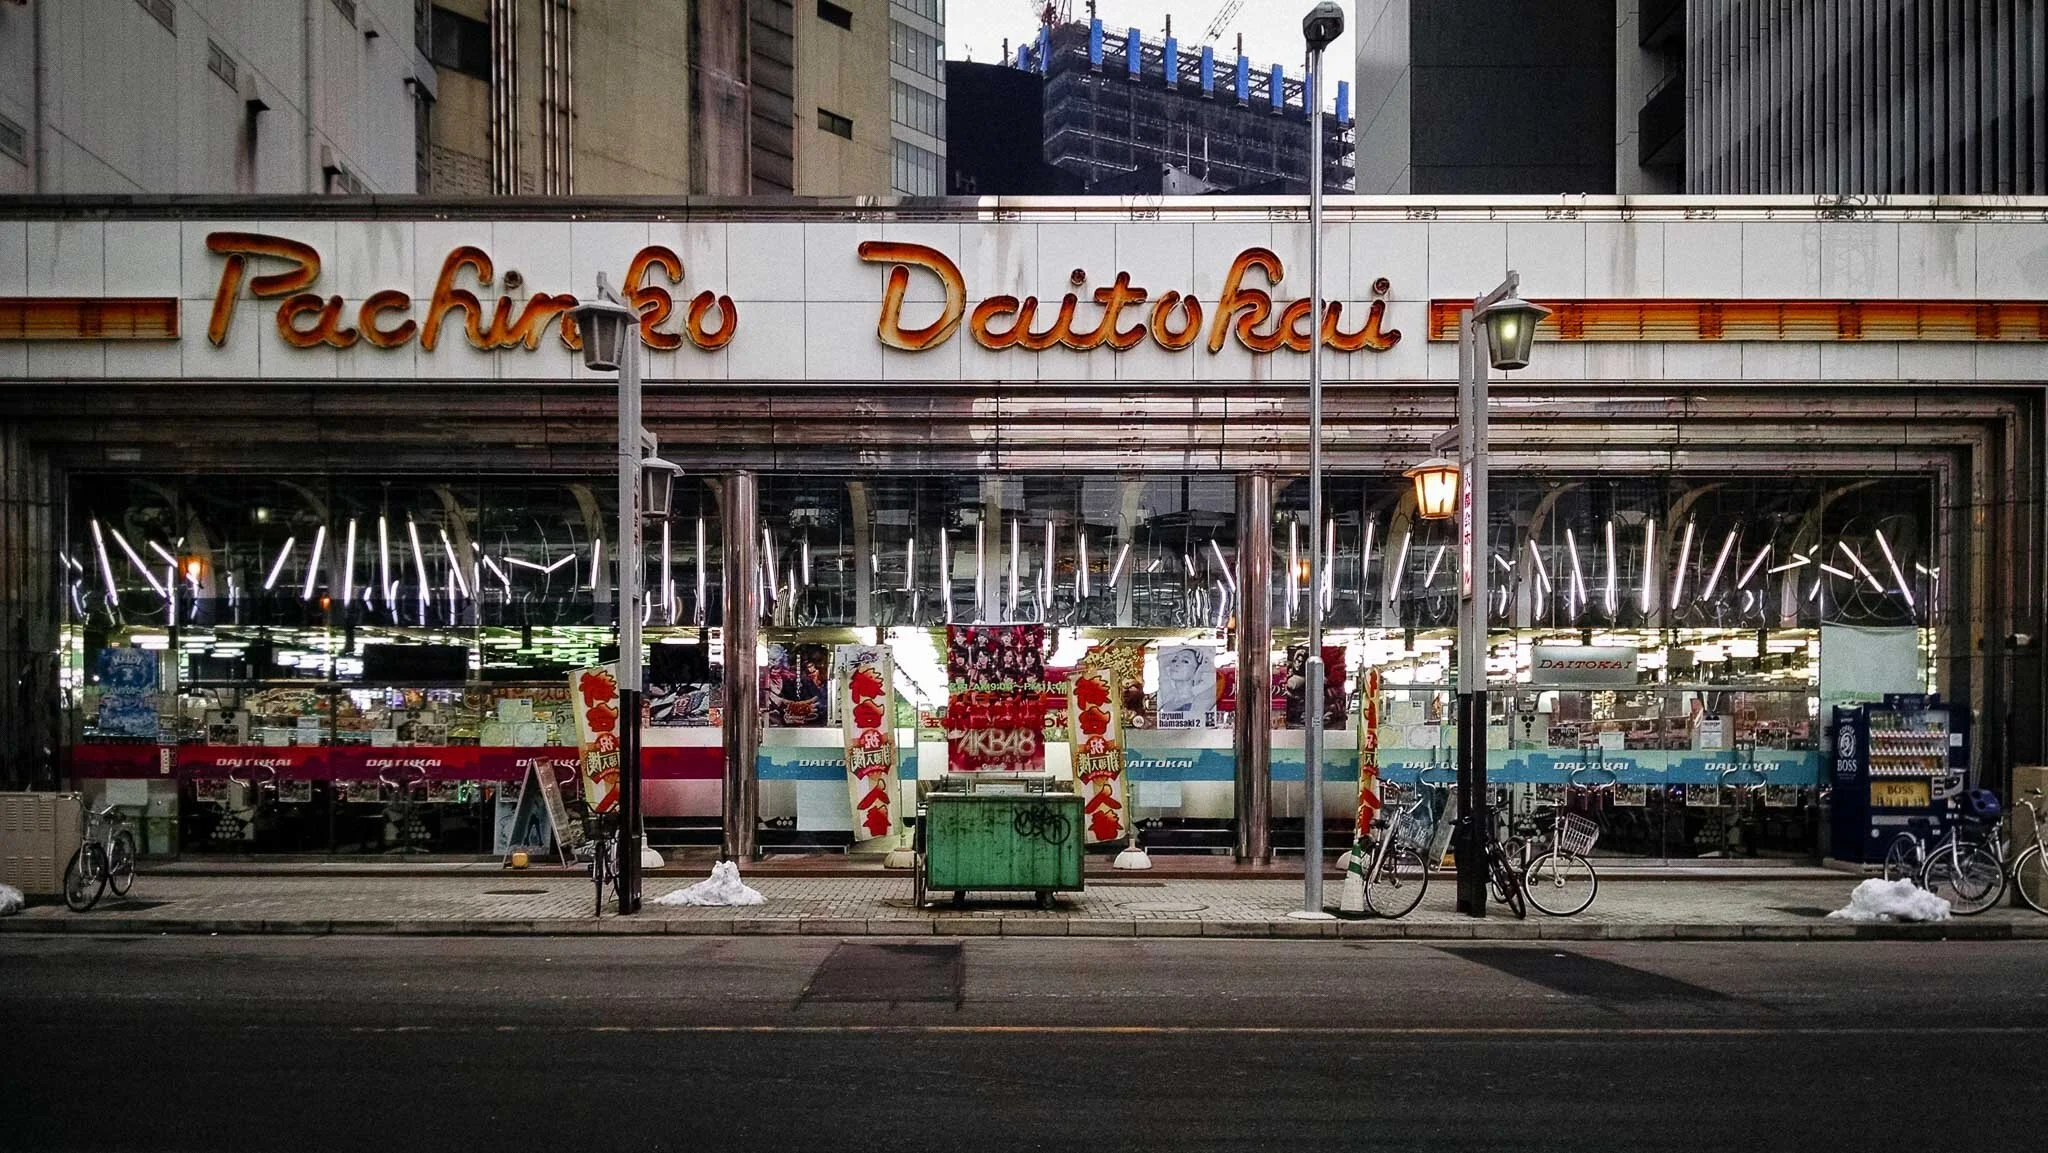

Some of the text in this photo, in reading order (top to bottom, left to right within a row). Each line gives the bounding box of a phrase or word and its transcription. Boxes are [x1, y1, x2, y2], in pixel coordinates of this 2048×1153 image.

[205, 231, 1402, 352] Pachinko Daitokai
[1537, 659, 1633, 670] DAITOKAI
[1159, 719, 1194, 728] hamasaki
[957, 728, 1036, 757] AKB48
[216, 758, 291, 767] DAITOKAI
[366, 758, 441, 767] DAITOKAI
[800, 758, 846, 767] DAITO
[1123, 759, 1194, 768] AITOKAI
[1553, 762, 1629, 770] DAITOKAI
[1704, 762, 1780, 770] DAITOKAI
[1837, 759, 1857, 772] BOSS
[1887, 785, 1913, 795] BOSS
